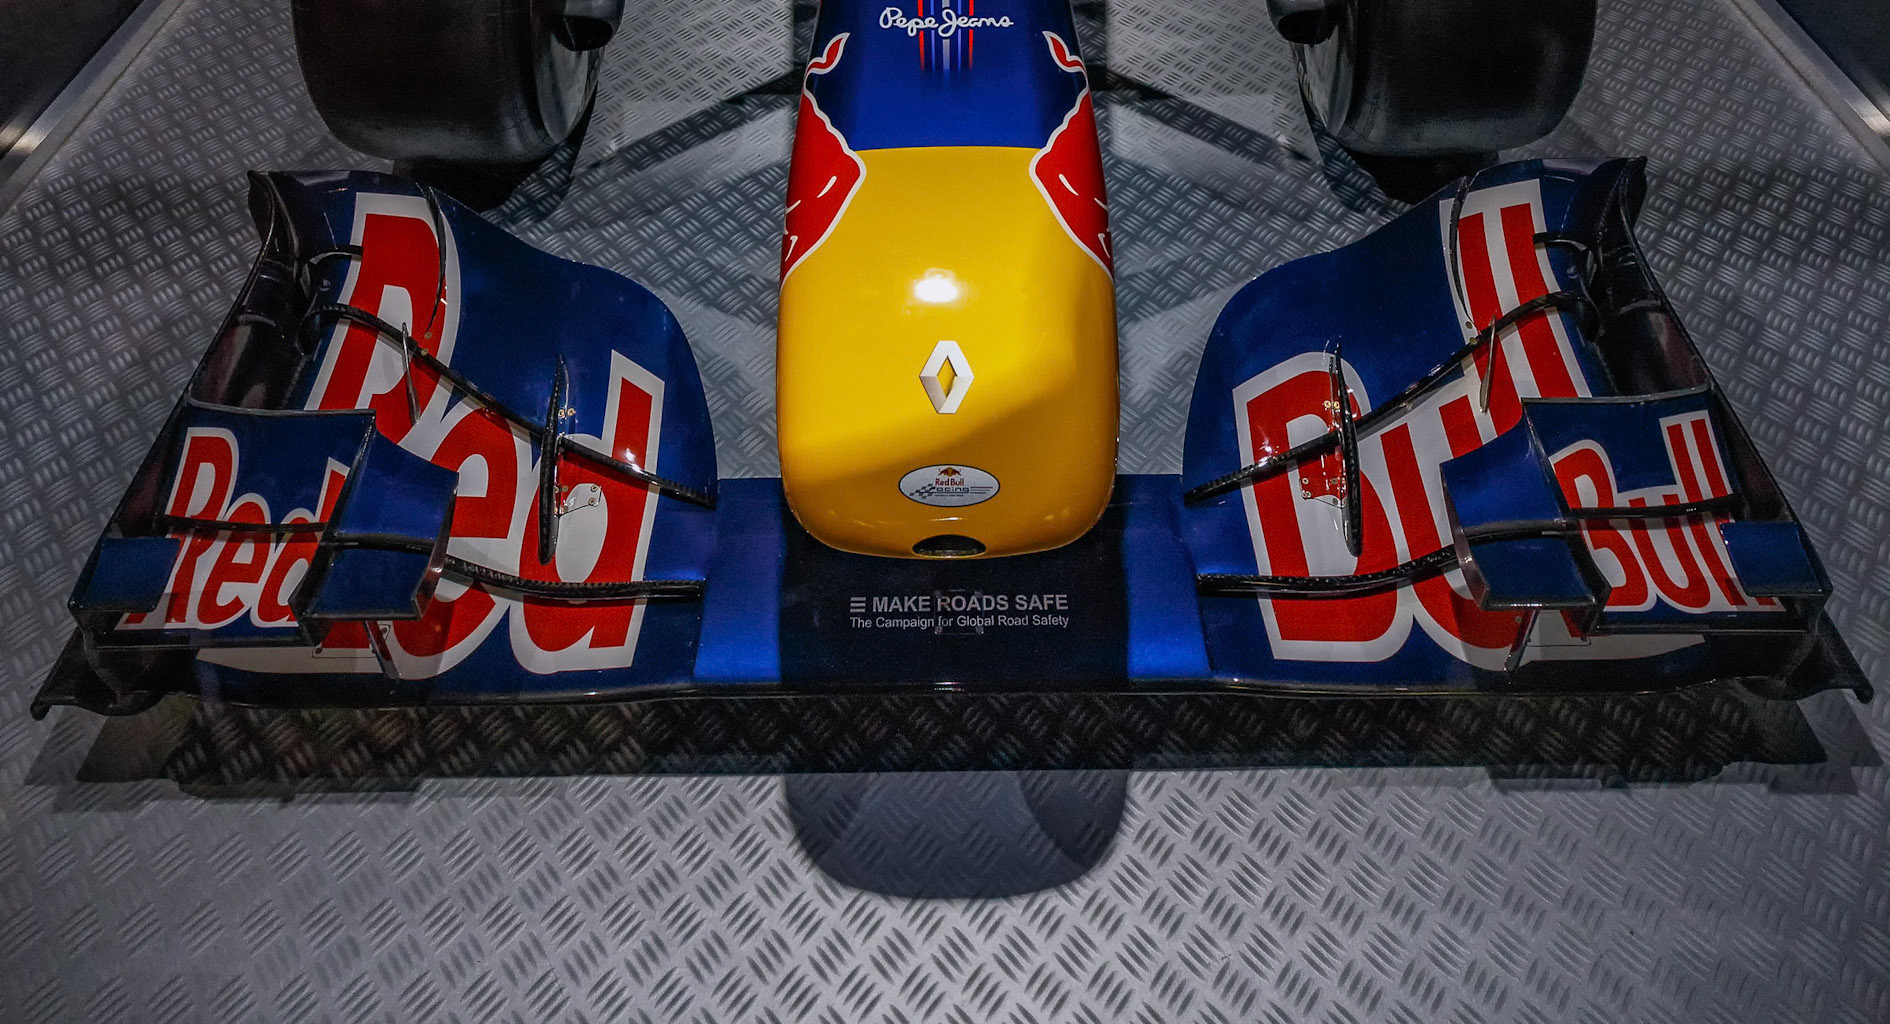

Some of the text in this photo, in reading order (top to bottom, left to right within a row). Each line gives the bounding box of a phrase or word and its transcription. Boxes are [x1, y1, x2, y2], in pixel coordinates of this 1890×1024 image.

[879, 7, 1014, 37] Pepe Jeans
[196, 191, 665, 680] Red
[935, 478, 964, 486] Red Bull
[1232, 178, 1615, 672] Bull
[114, 427, 351, 631] Red
[1548, 410, 1786, 614] Bull
[849, 614, 1069, 630] The Campaign for Global Road Safety
[872, 594, 1068, 612] MAKE ROADS SAFE
